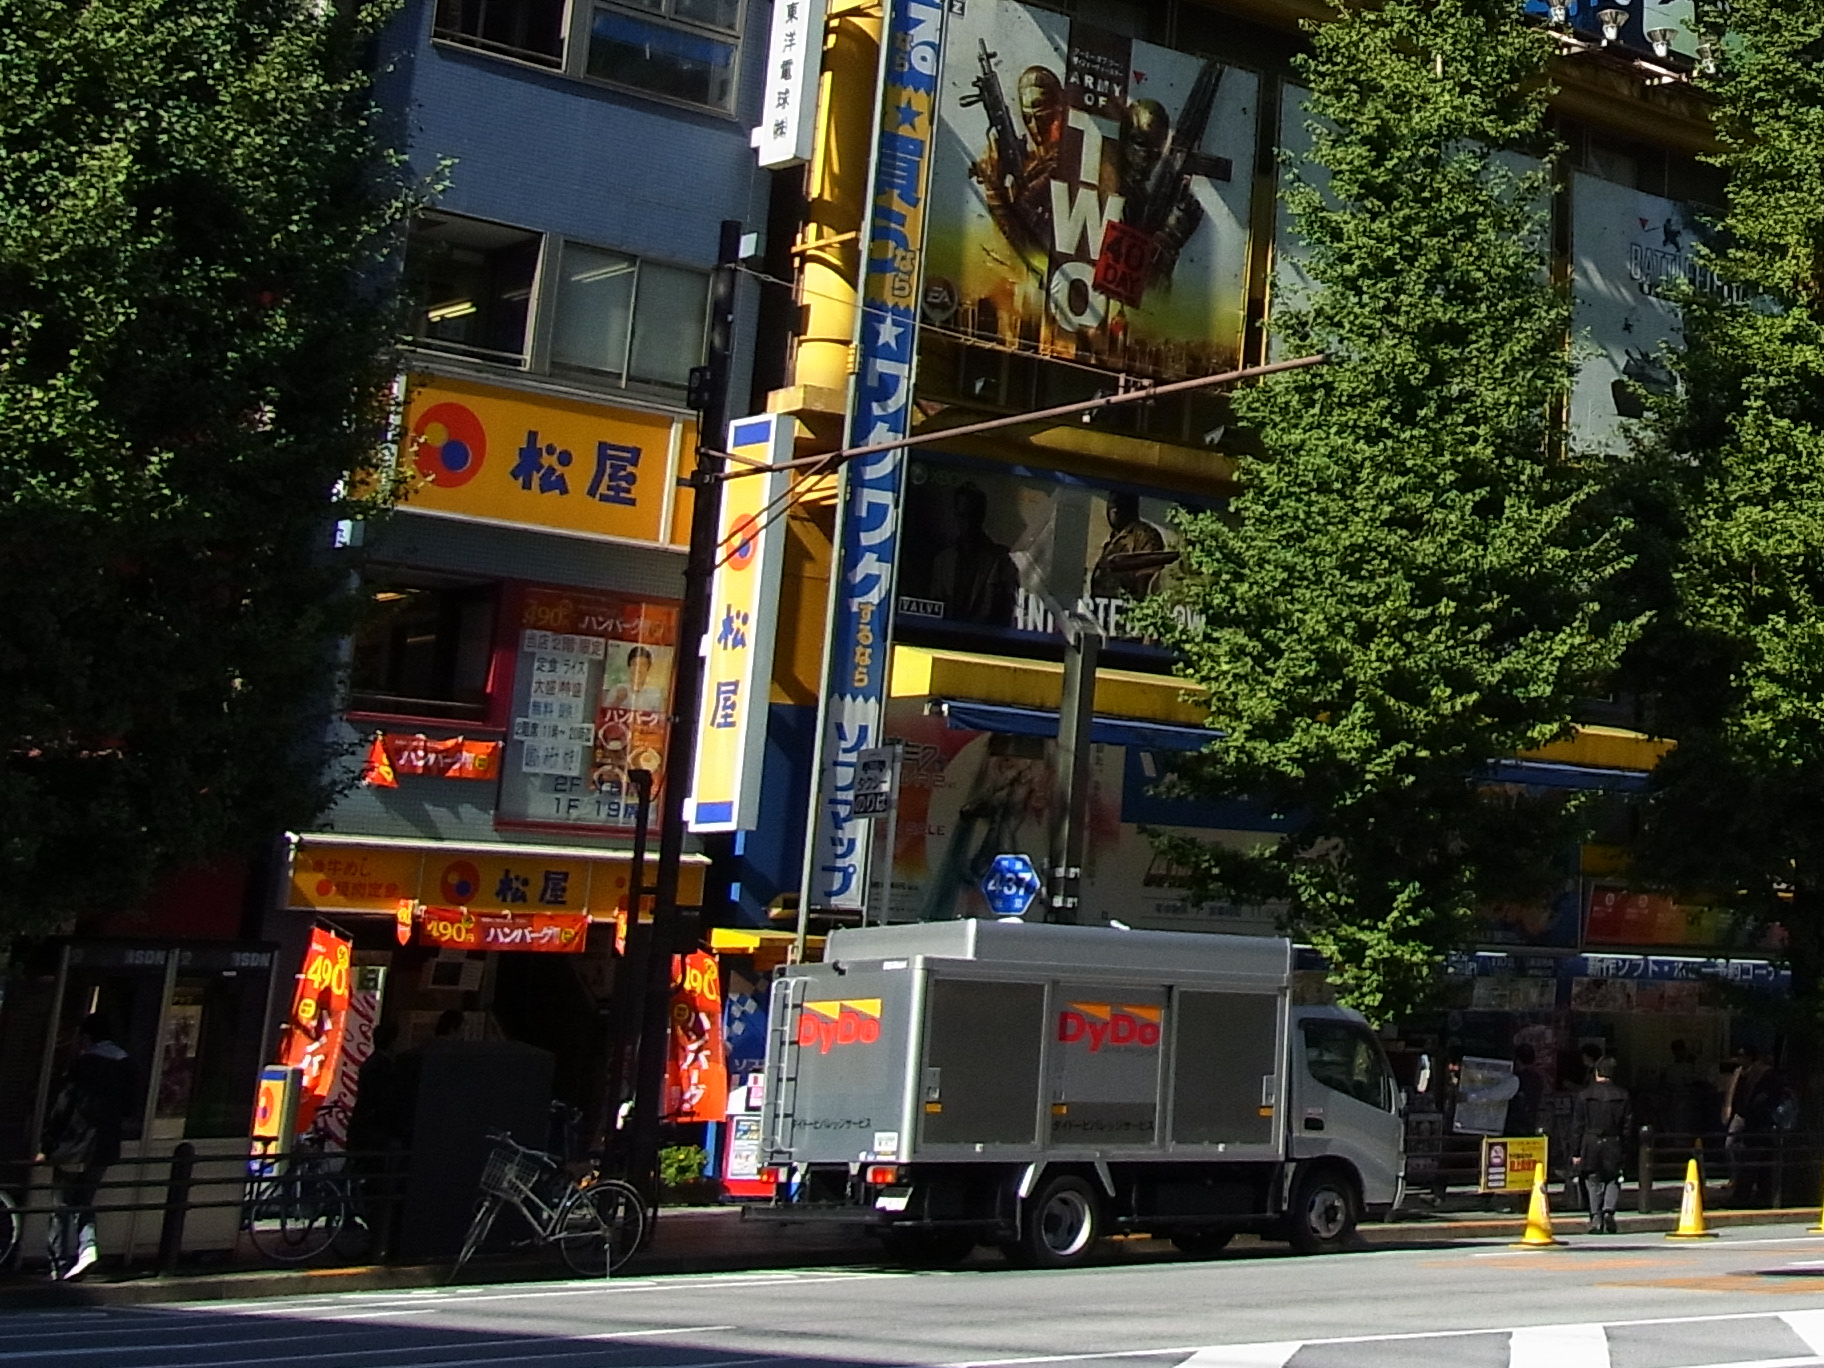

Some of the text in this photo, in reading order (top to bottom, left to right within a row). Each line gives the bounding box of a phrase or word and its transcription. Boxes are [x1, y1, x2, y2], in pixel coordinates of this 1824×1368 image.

[1070, 72, 1121, 97] ARMY
[1084, 93, 1107, 108] OF
[927, 291, 952, 305] EA
[510, 430, 641, 506] 松屋
[708, 603, 750, 728] 松屋
[554, 776, 582, 792] 2F
[554, 797, 580, 815] 1F
[495, 868, 570, 907] 松屋
[986, 872, 1032, 897] 437
[799, 1011, 882, 1054] DyDo
[1058, 1011, 1160, 1053] DyDo
